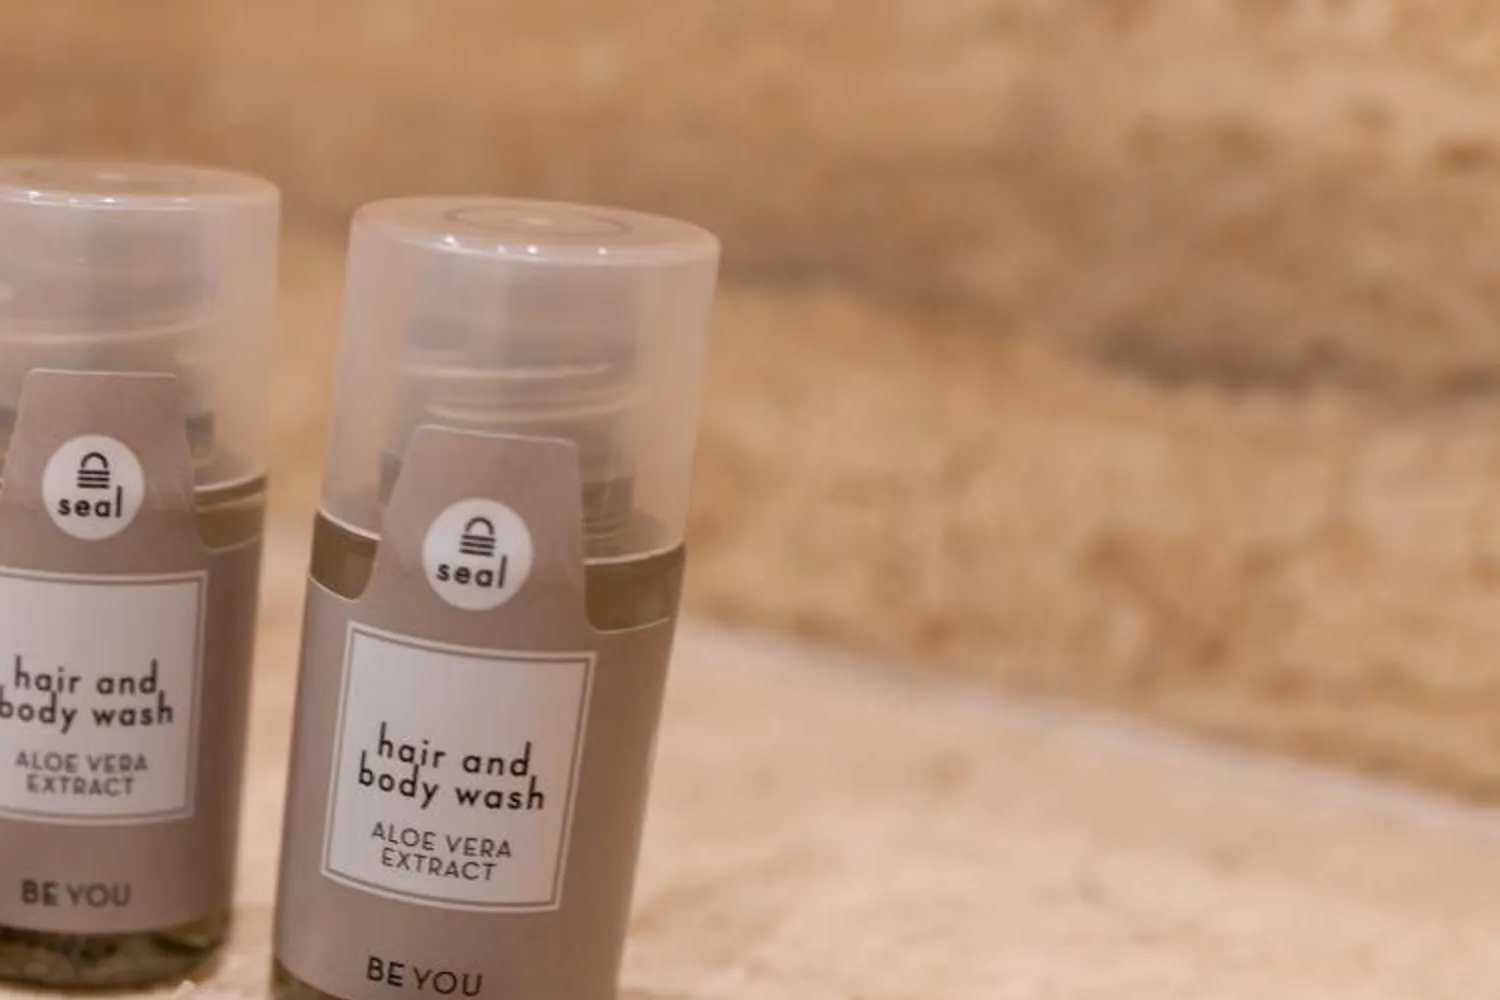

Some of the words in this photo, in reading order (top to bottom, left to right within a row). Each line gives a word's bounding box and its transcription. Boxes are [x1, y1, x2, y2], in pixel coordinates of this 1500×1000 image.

[57, 485, 123, 518] seal
[436, 554, 508, 589] seal
[13, 655, 82, 694] hair
[96, 658, 159, 696] and
[92, 690, 174, 727] wash
[14, 750, 79, 774] ALOE
[86, 753, 149, 774] VERA
[377, 721, 447, 769] hair
[462, 741, 532, 777] and
[25, 774, 136, 797] EXTRACT
[358, 749, 440, 810] body
[455, 775, 546, 811] wash
[371, 821, 437, 851] ALOE
[446, 835, 512, 859] VERA
[381, 847, 498, 881] EXTRACT
[367, 955, 405, 987] BE
[412, 965, 484, 998] YOU
